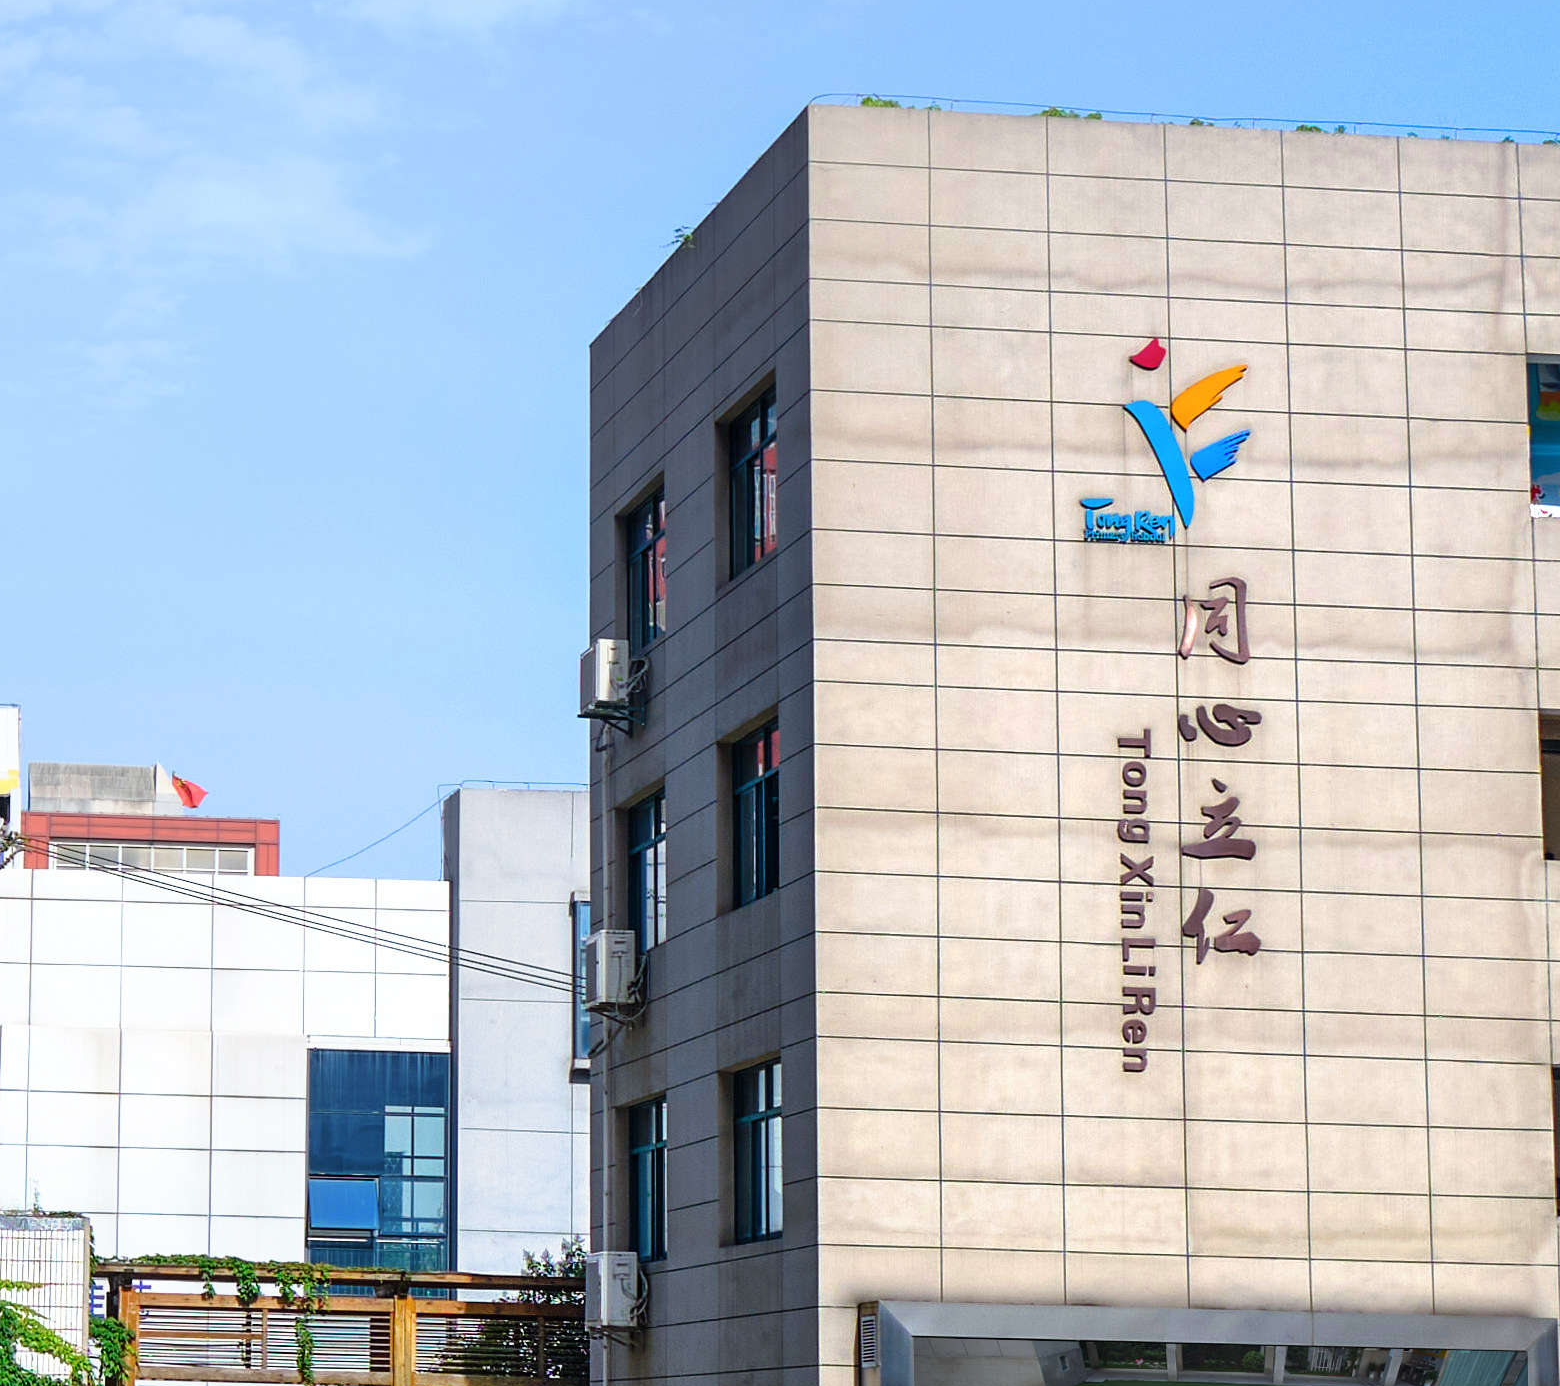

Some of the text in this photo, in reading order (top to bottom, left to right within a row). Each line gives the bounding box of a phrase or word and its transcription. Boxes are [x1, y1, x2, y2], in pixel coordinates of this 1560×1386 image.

[1080, 498, 1176, 542] Tong Ren
[1115, 728, 1158, 1074] Tong Xin Li Ren
[1178, 576, 1263, 965] 同心立仁
